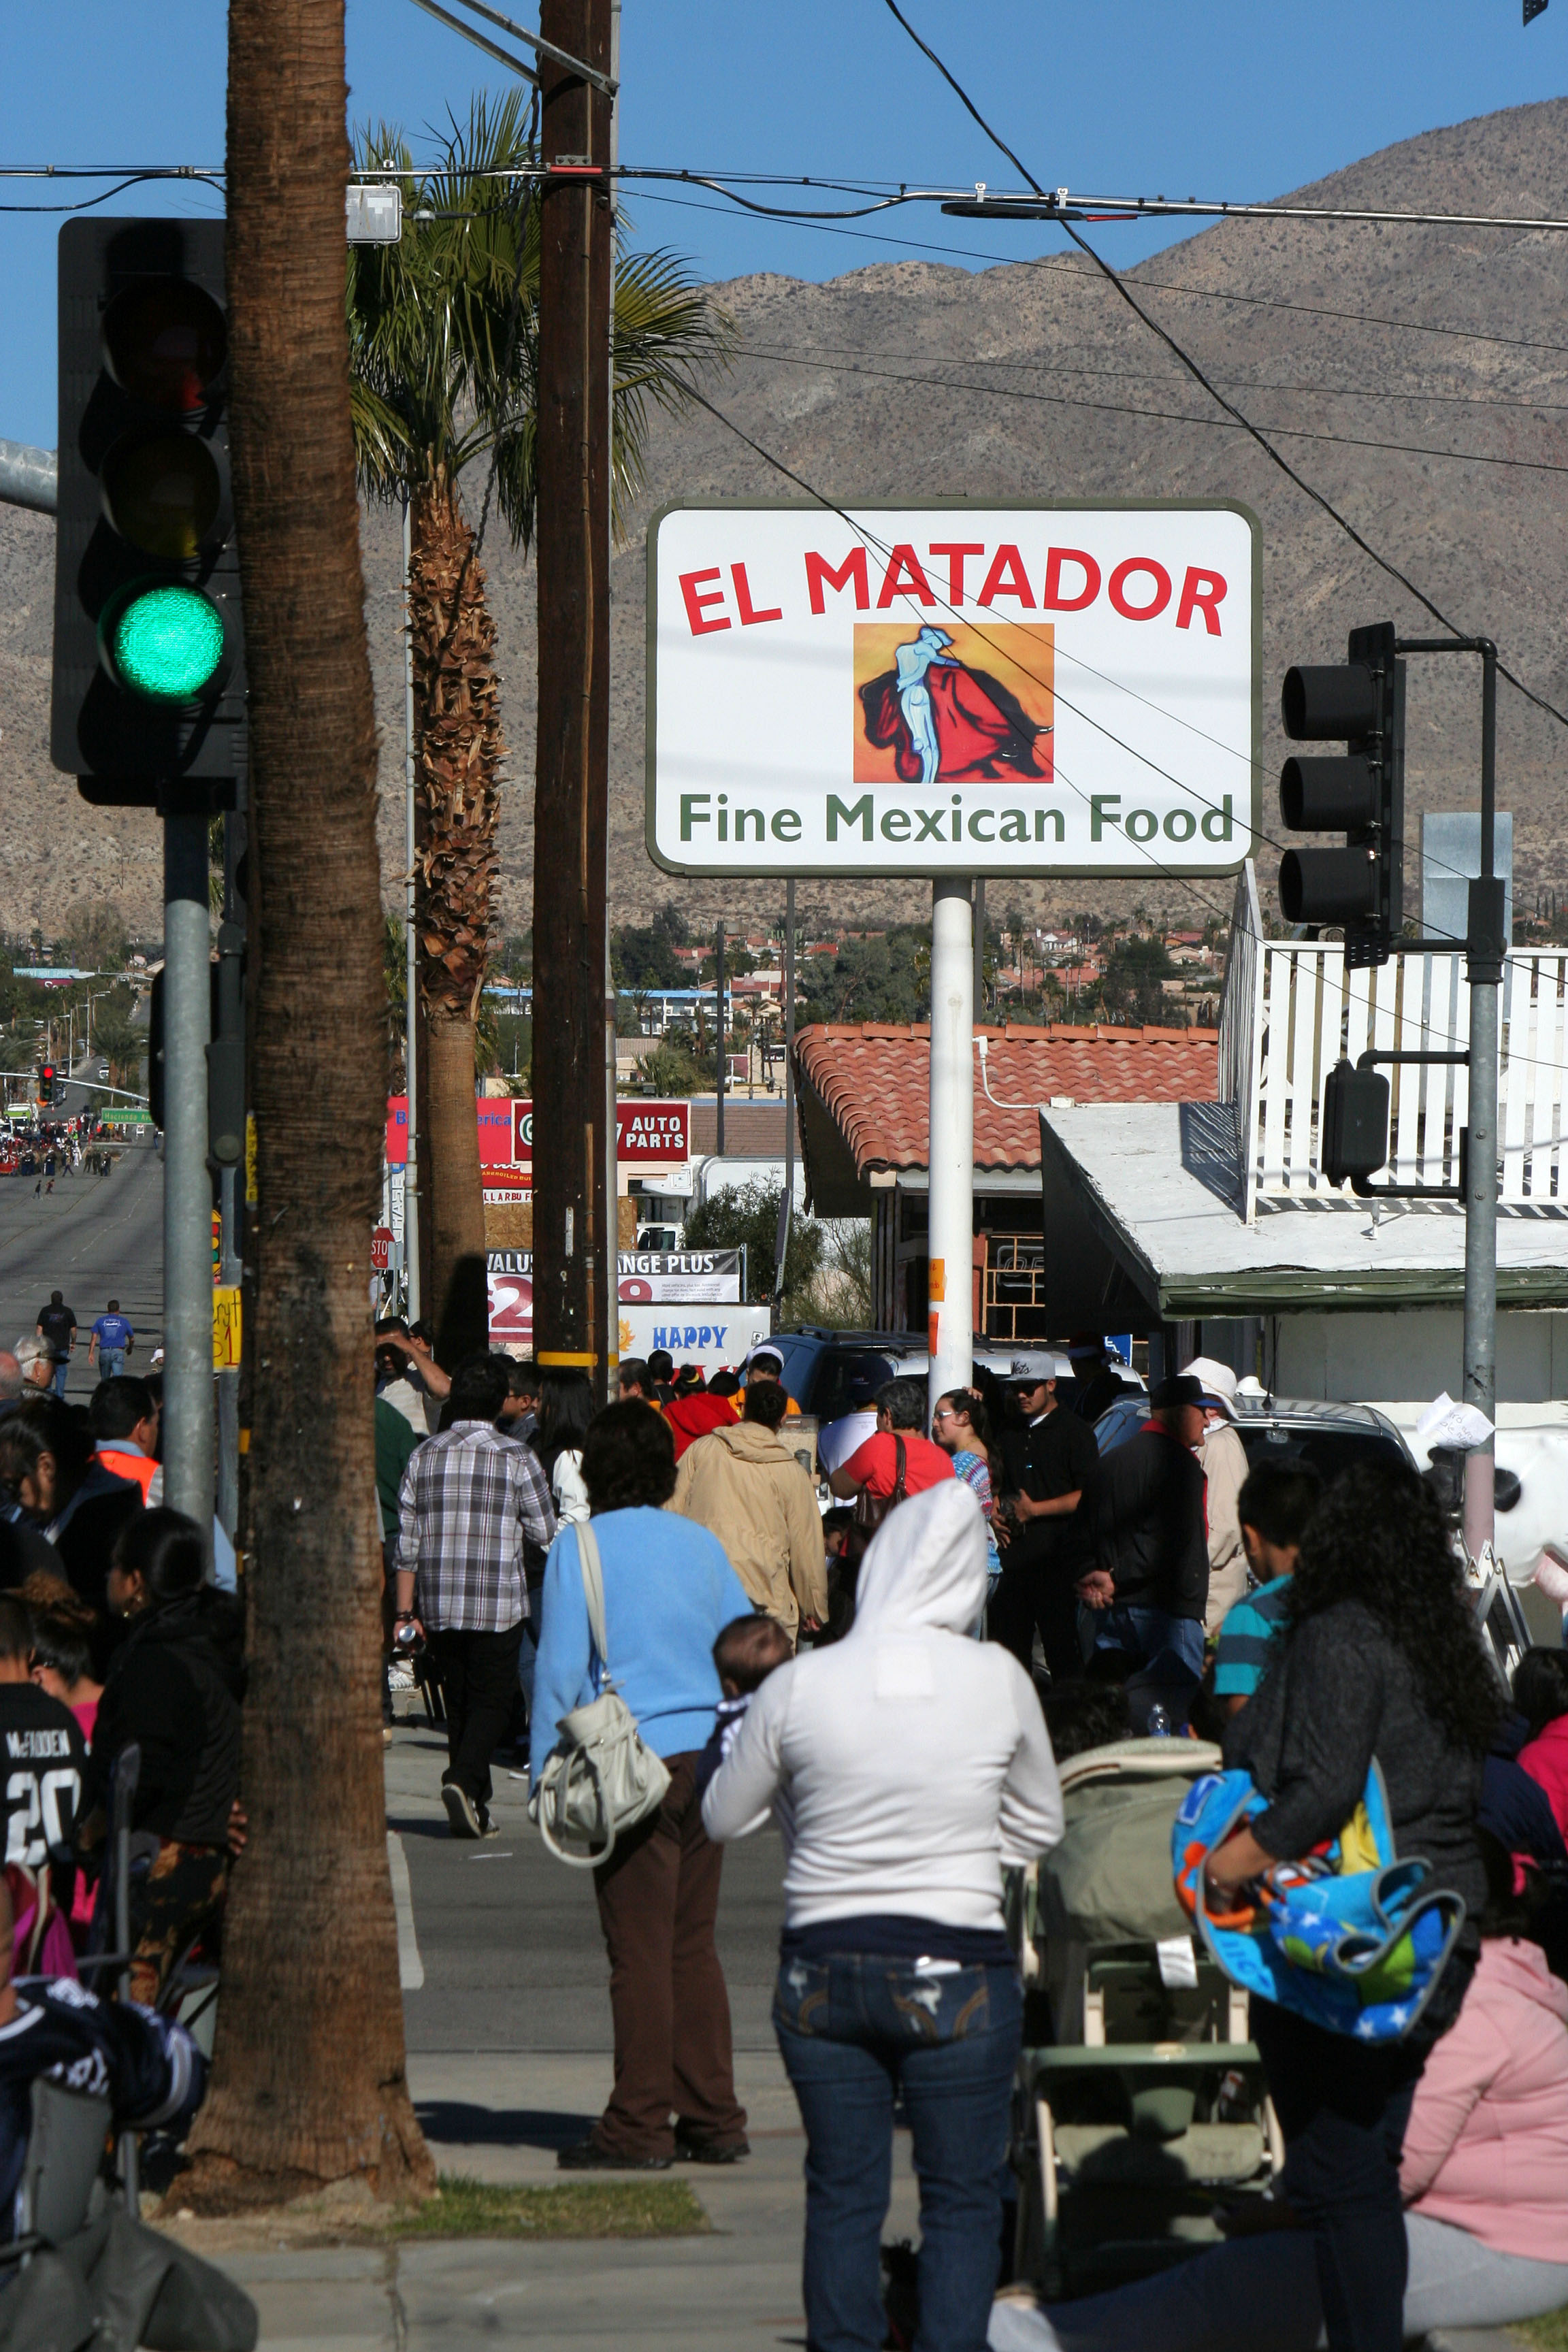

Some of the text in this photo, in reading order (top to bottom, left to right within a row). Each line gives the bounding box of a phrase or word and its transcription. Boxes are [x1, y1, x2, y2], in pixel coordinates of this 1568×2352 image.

[679, 543, 1228, 636] EL MATADOR
[680, 794, 1233, 843] Fine Mexican Food
[104, 1112, 137, 1121] Hacienda
[478, 1111, 511, 1126] erica
[631, 1116, 681, 1132] AUTO
[625, 1132, 685, 1148] PARTS
[372, 1240, 388, 1256] STO
[668, 1254, 714, 1273] PLUS
[653, 1325, 729, 1350] HAPPY
[1012, 1361, 1032, 1375] Nets
[5, 1767, 81, 1865] 20
